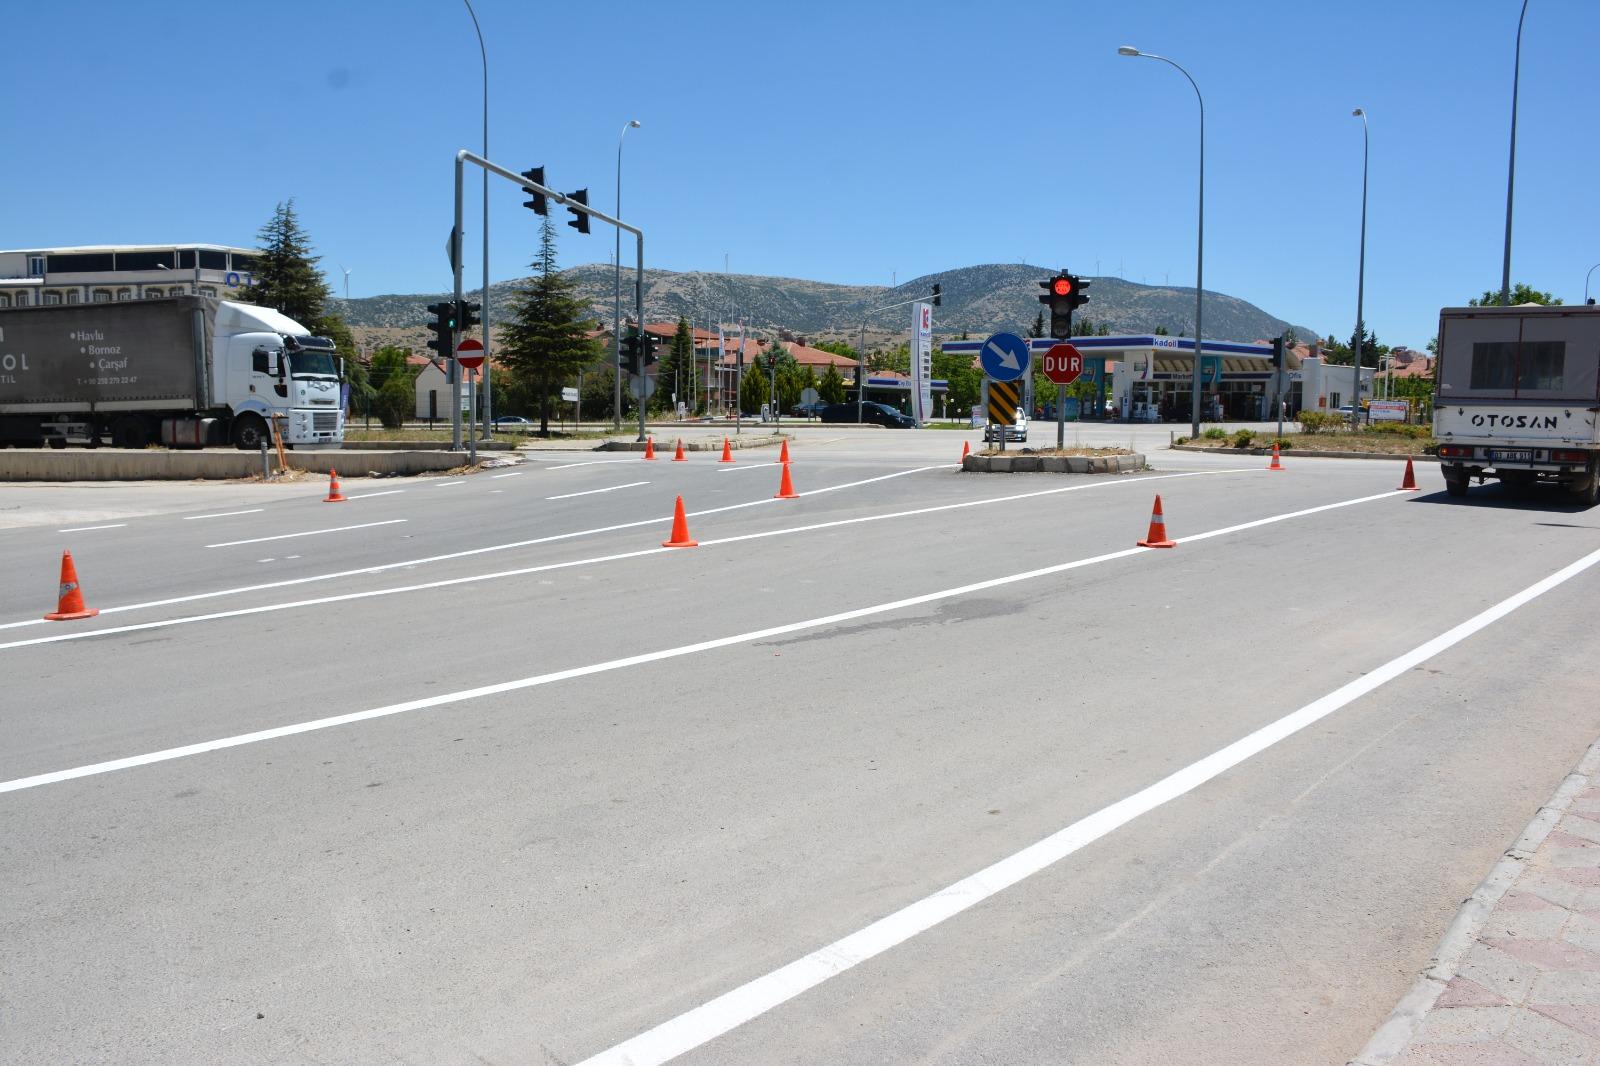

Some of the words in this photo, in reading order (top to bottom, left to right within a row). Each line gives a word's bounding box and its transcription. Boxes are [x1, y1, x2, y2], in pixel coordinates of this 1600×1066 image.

[77, 330, 104, 341] Havlu
[1154, 339, 1177, 347] kadoil
[88, 345, 121, 355] Bornoz
[98, 357, 128, 371] Çarşaf
[1045, 356, 1080, 372] DUR
[1471, 414, 1558, 429] OTOSAN
